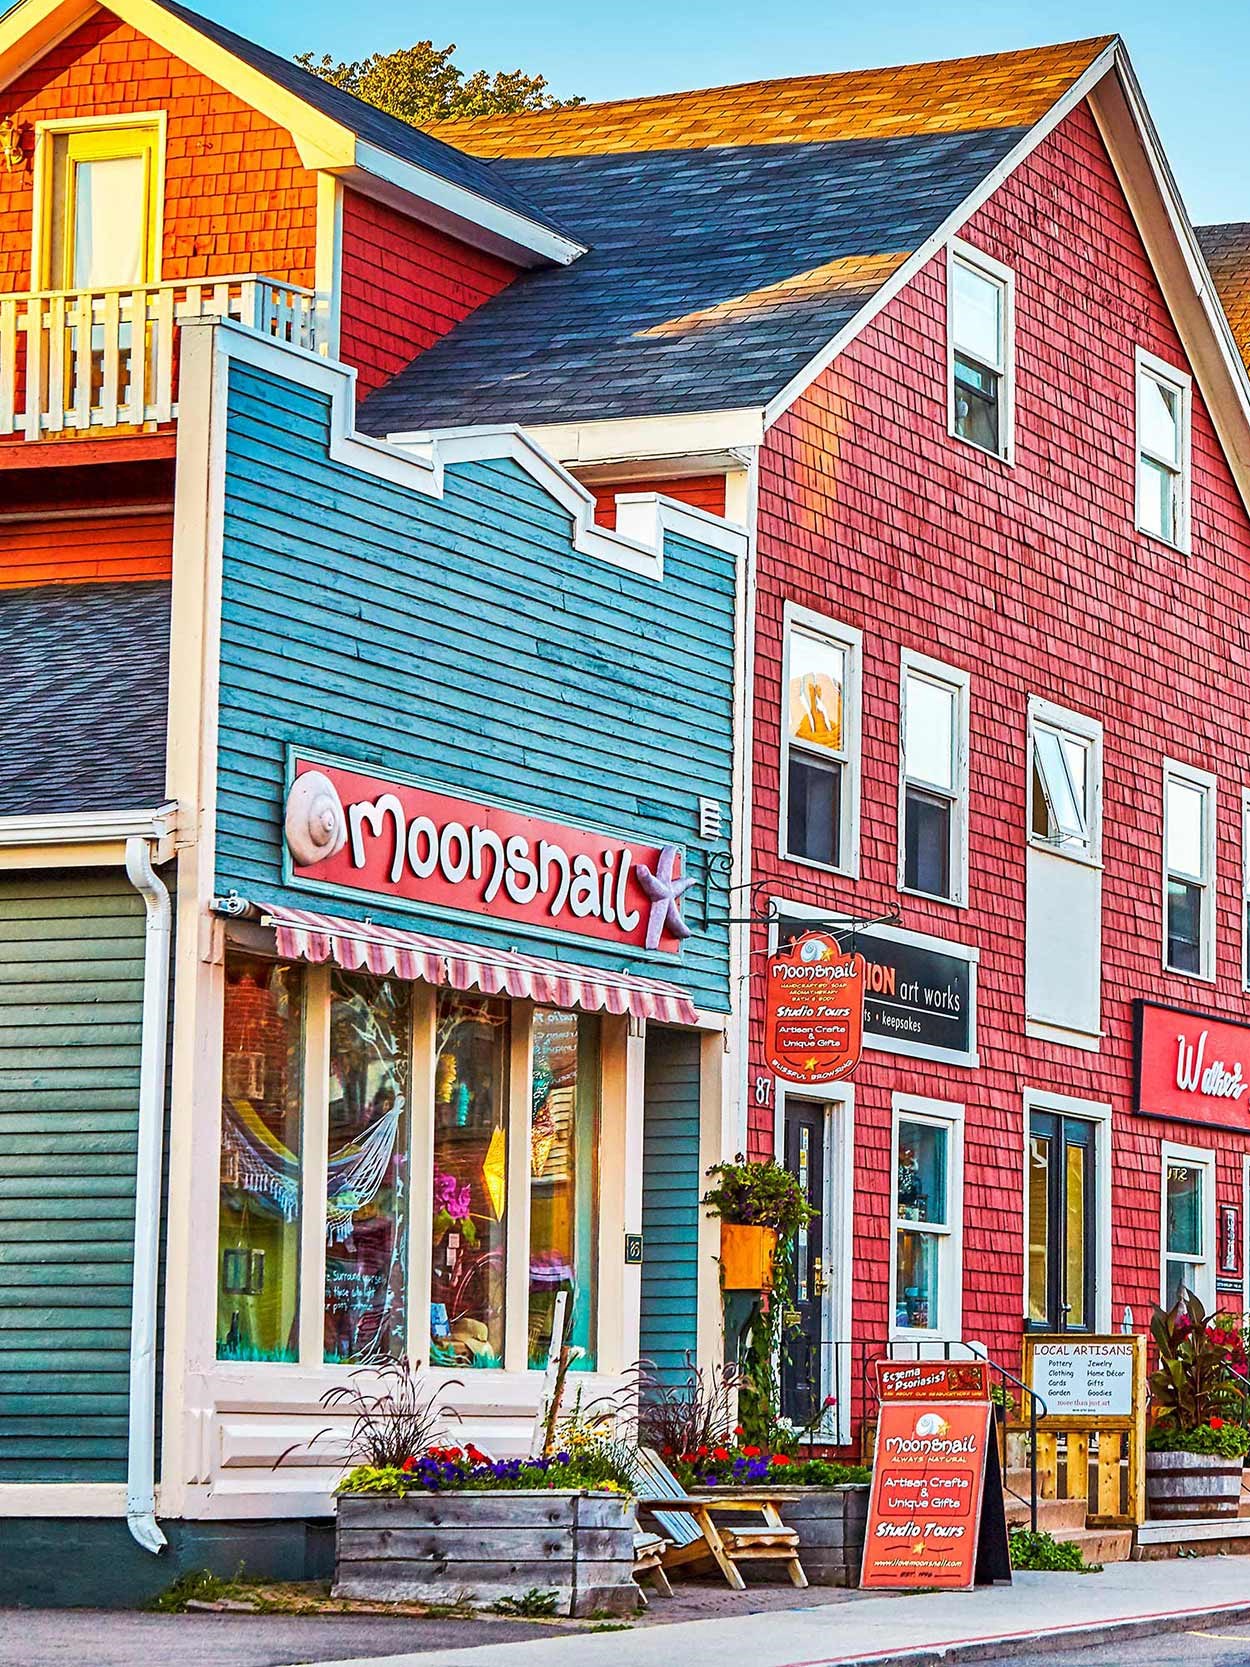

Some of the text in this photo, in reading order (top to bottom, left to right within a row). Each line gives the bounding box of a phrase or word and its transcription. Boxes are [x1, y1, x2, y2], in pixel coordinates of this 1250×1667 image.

[772, 961, 857, 981] Moonsnail
[900, 981, 919, 1002] art
[923, 985, 960, 1012] works
[777, 1006, 850, 1017] Studio Tours
[881, 1011, 921, 1032] keepsakes
[815, 1025, 846, 1033] Crafts
[783, 1040, 815, 1048] Unique
[772, 1059, 853, 1080] BLISSFUL BROWSING
[756, 1076, 771, 1105] 87
[1034, 1345, 1133, 1356] LOCAL ARTISANS
[1048, 1360, 1073, 1368] Pottery
[1087, 1360, 1113, 1368] Jewelry
[882, 1368, 921, 1382] Eczema
[1048, 1370, 1074, 1378] Clothing
[1106, 1369, 1125, 1377] Décor
[895, 1371, 945, 1391] Psoriasis?
[886, 1435, 976, 1455] Moonsnail
[884, 1477, 969, 1488] Artisan Crafts
[920, 1488, 929, 1497] &
[888, 1498, 960, 1509] Unique Gifts
[876, 1521, 964, 1537] Studio Tours
